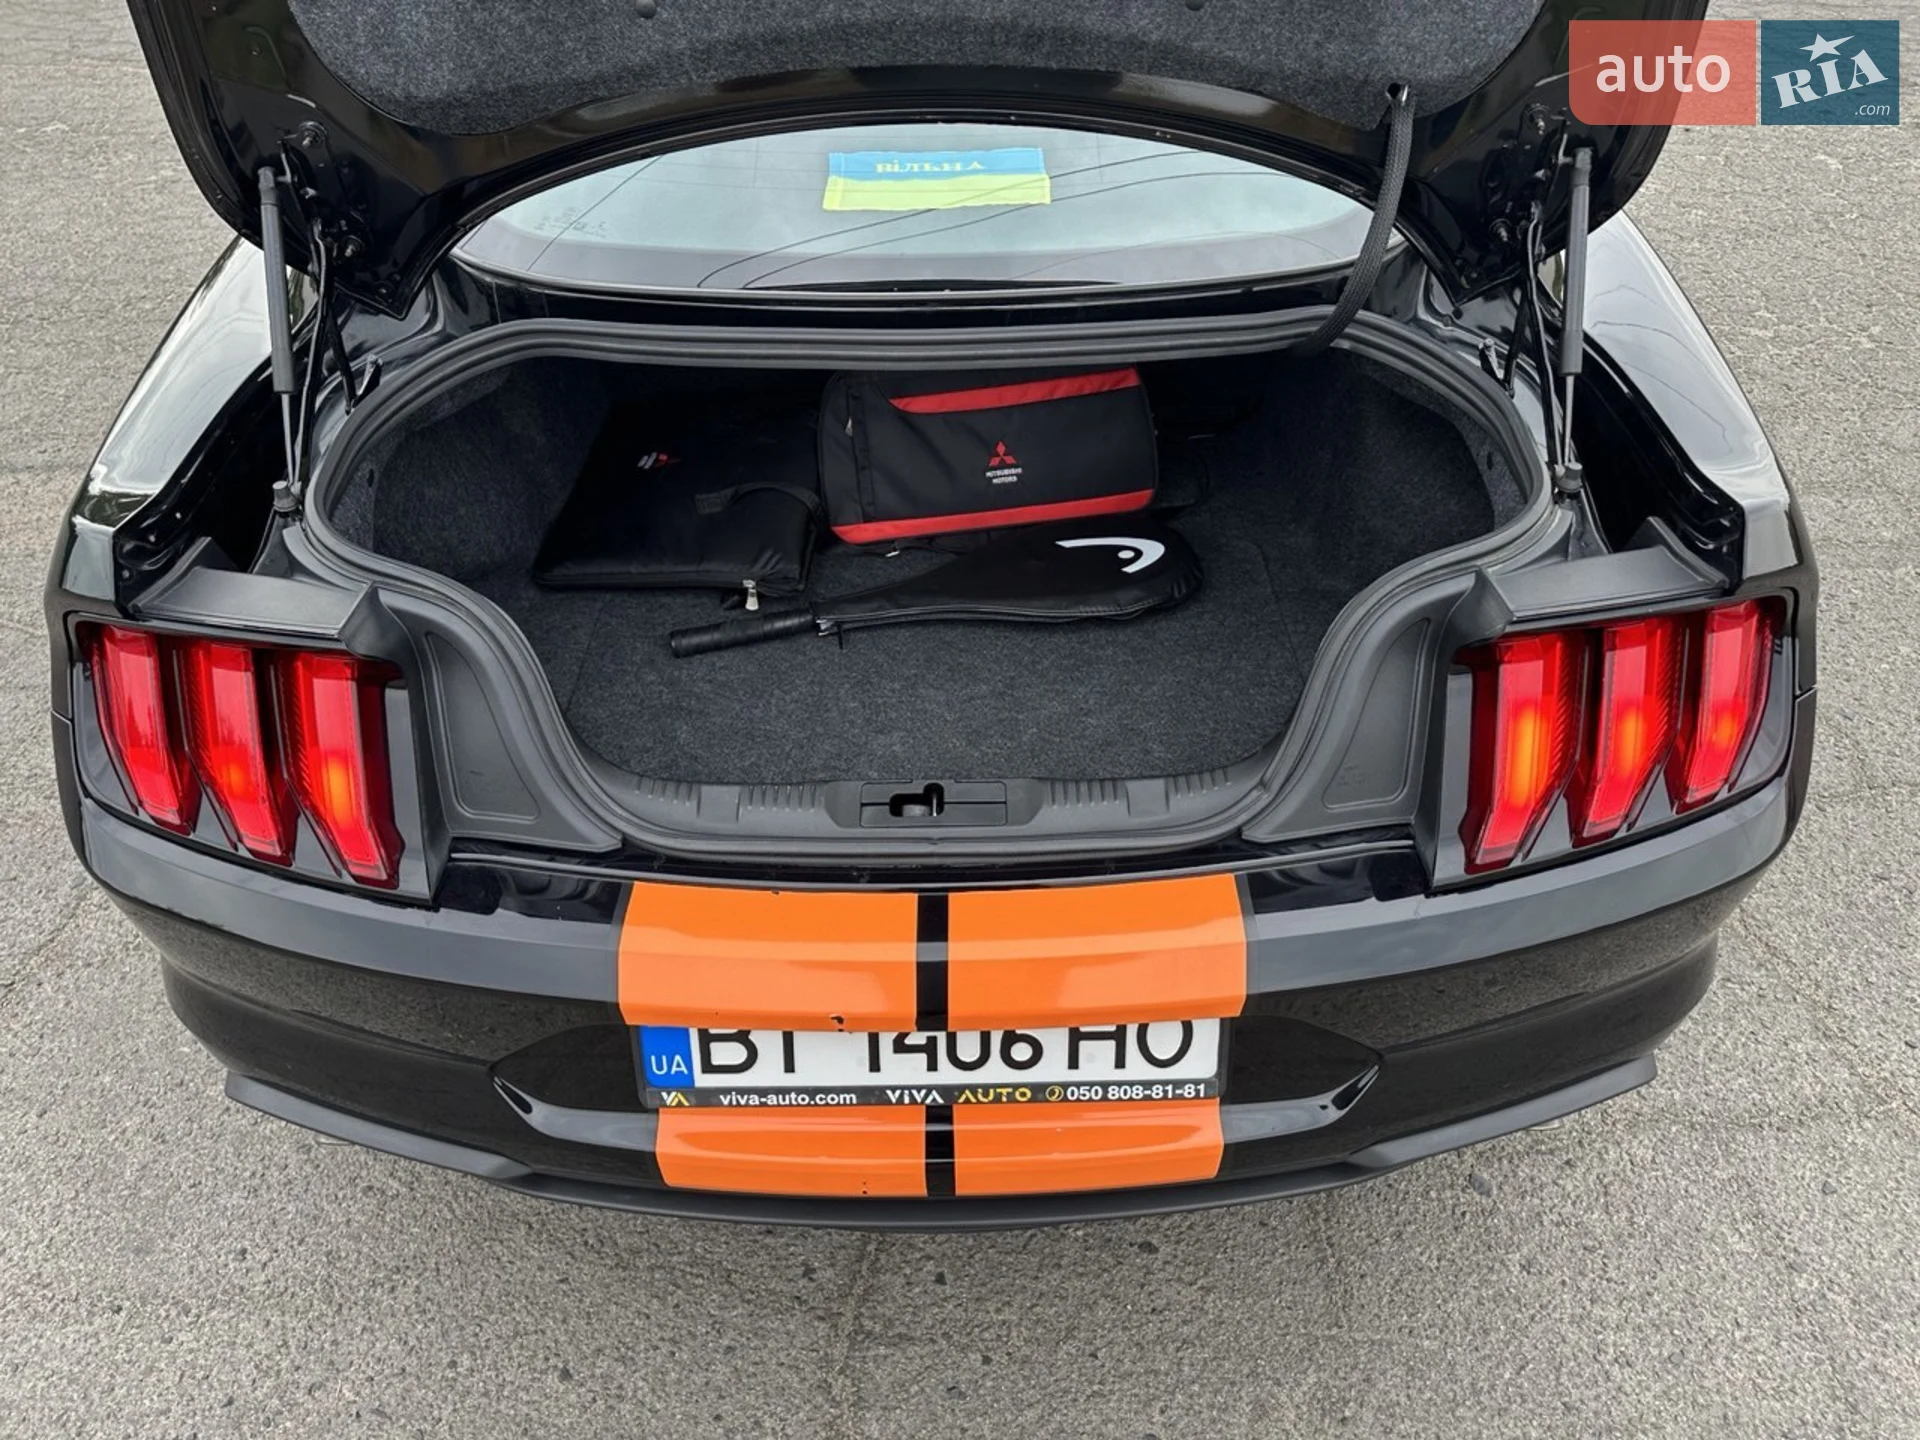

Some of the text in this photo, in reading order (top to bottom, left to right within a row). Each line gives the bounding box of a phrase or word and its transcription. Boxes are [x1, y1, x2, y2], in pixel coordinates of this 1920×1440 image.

[650, 1054, 688, 1075] UA
[719, 1091, 857, 1105] viva-auto.com
[957, 1087, 1032, 1103] AUTO
[1066, 1084, 1206, 1100] 050 808-81-81
